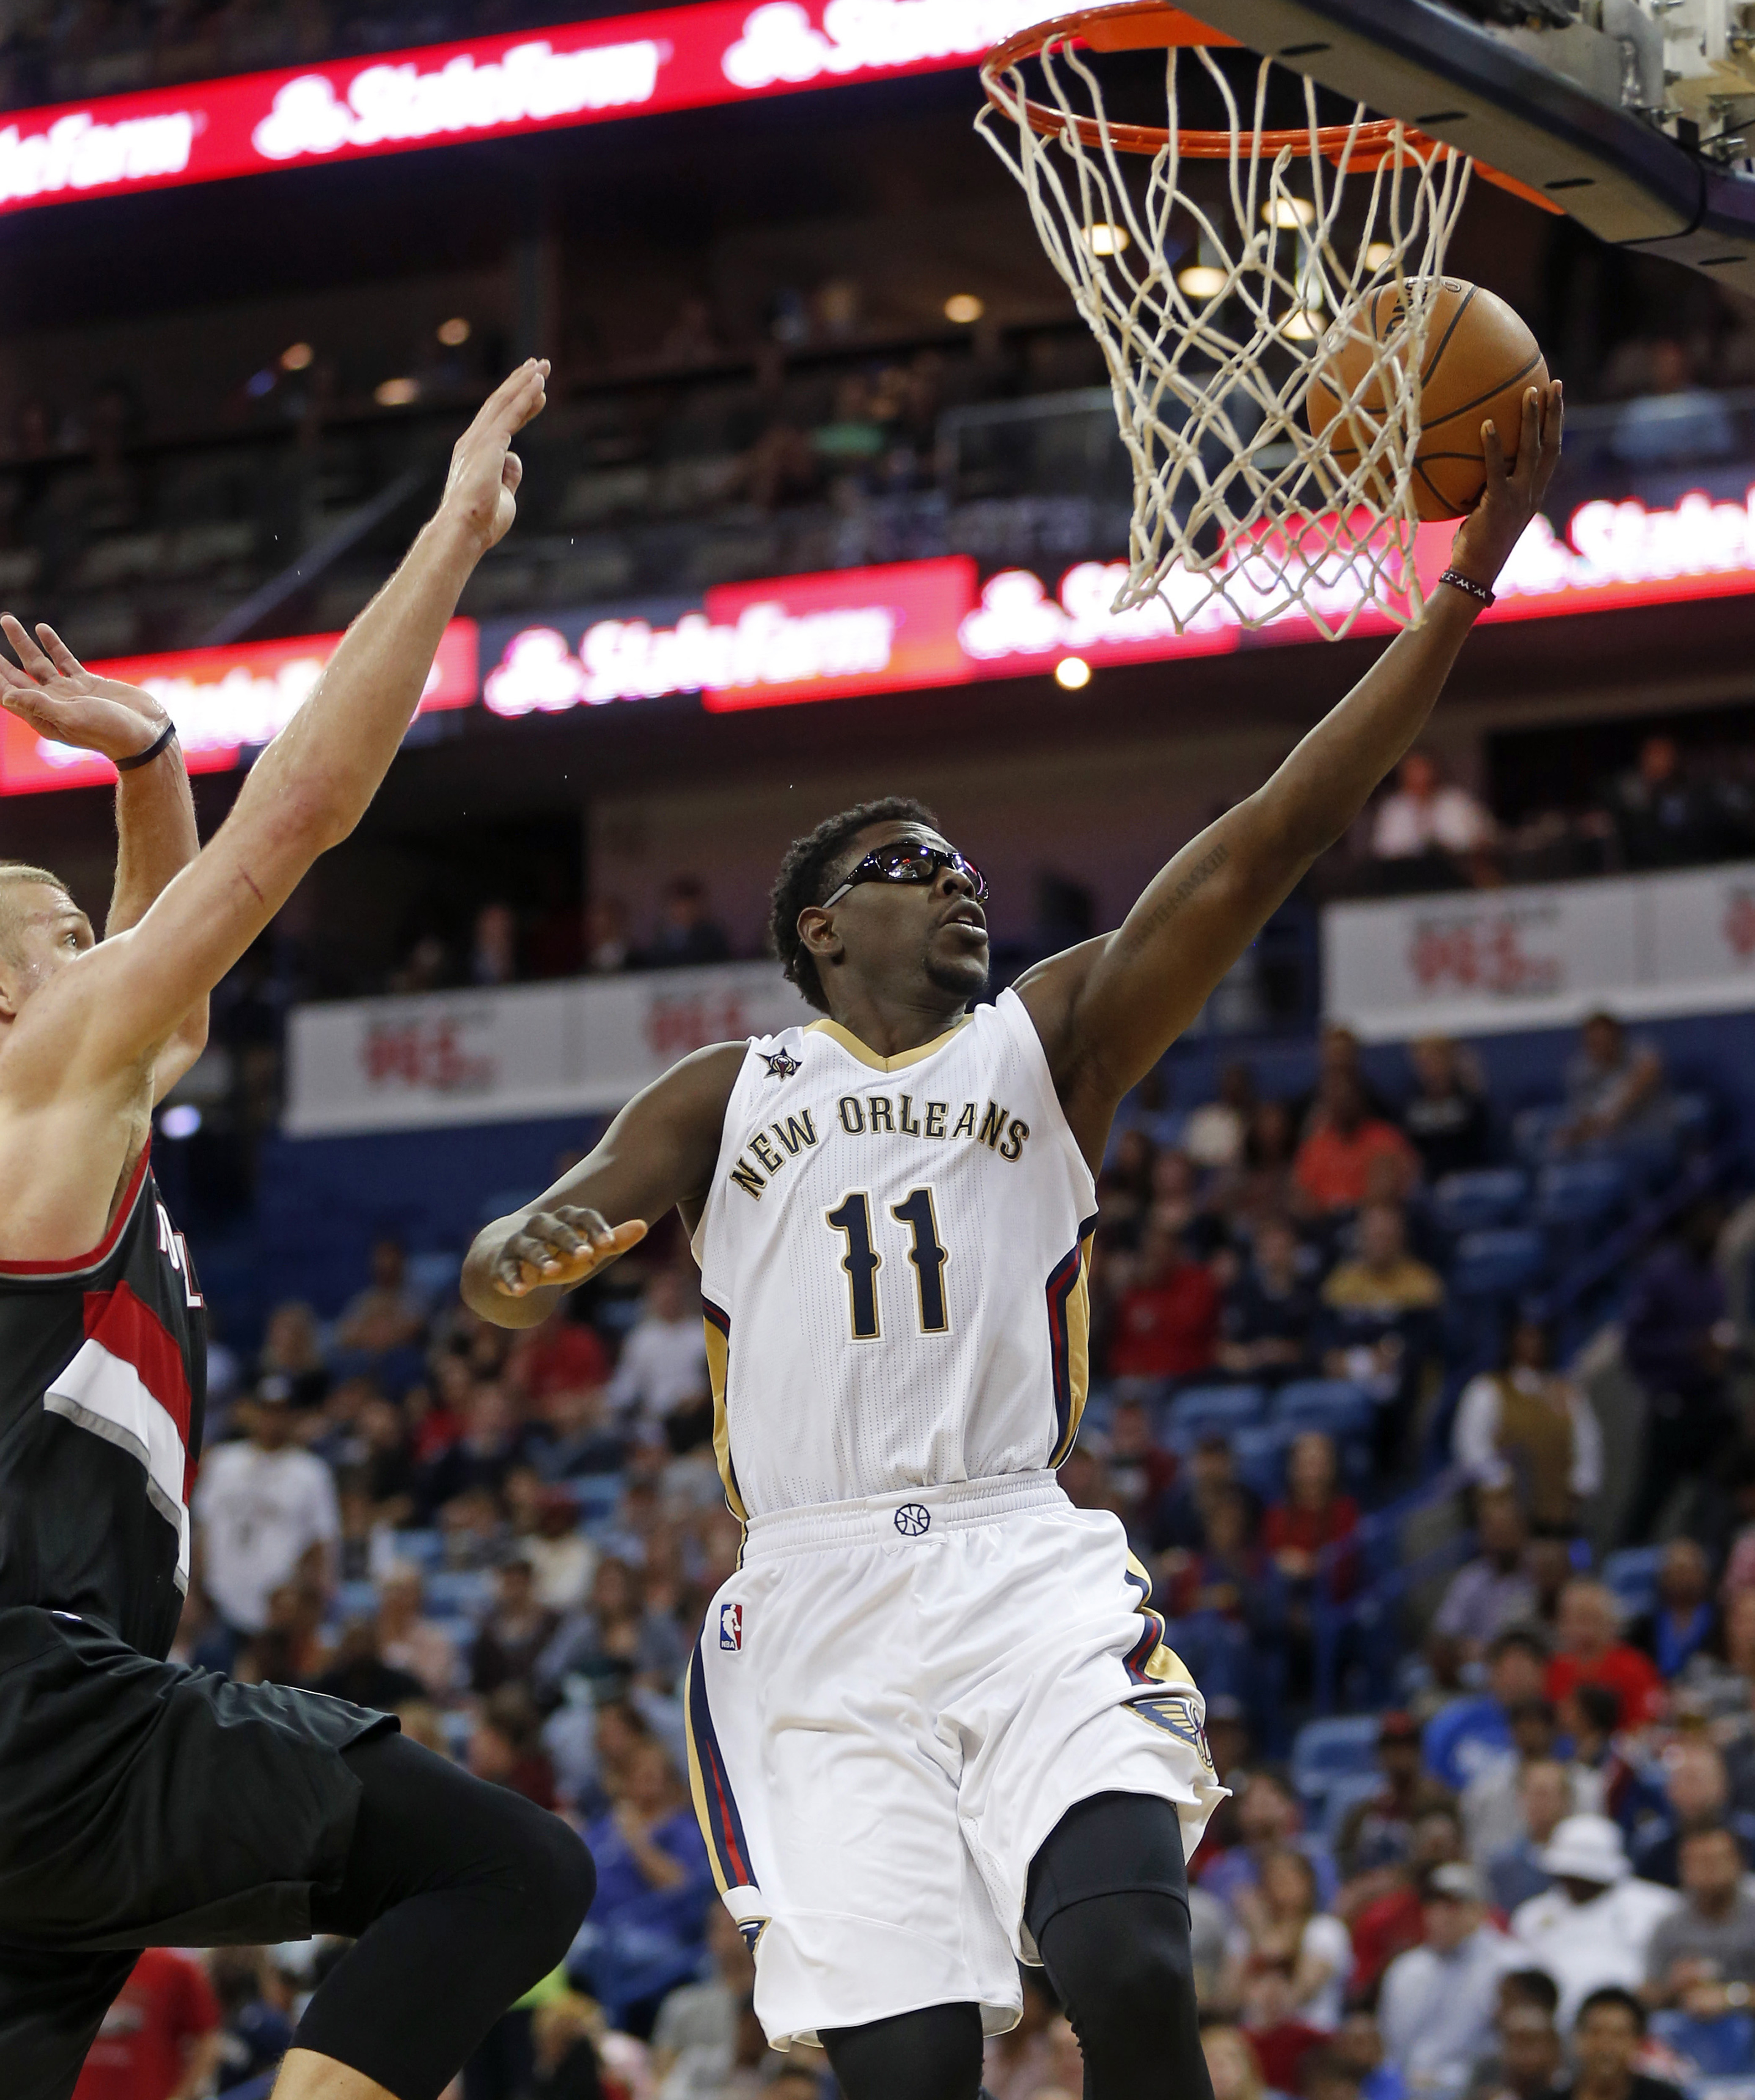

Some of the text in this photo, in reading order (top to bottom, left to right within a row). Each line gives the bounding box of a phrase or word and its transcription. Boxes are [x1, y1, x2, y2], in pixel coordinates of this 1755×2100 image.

[729, 1093, 1030, 1202] NEW ORLEANS
[823, 1185, 952, 1342] 11
[721, 1640, 735, 1649] NBA
